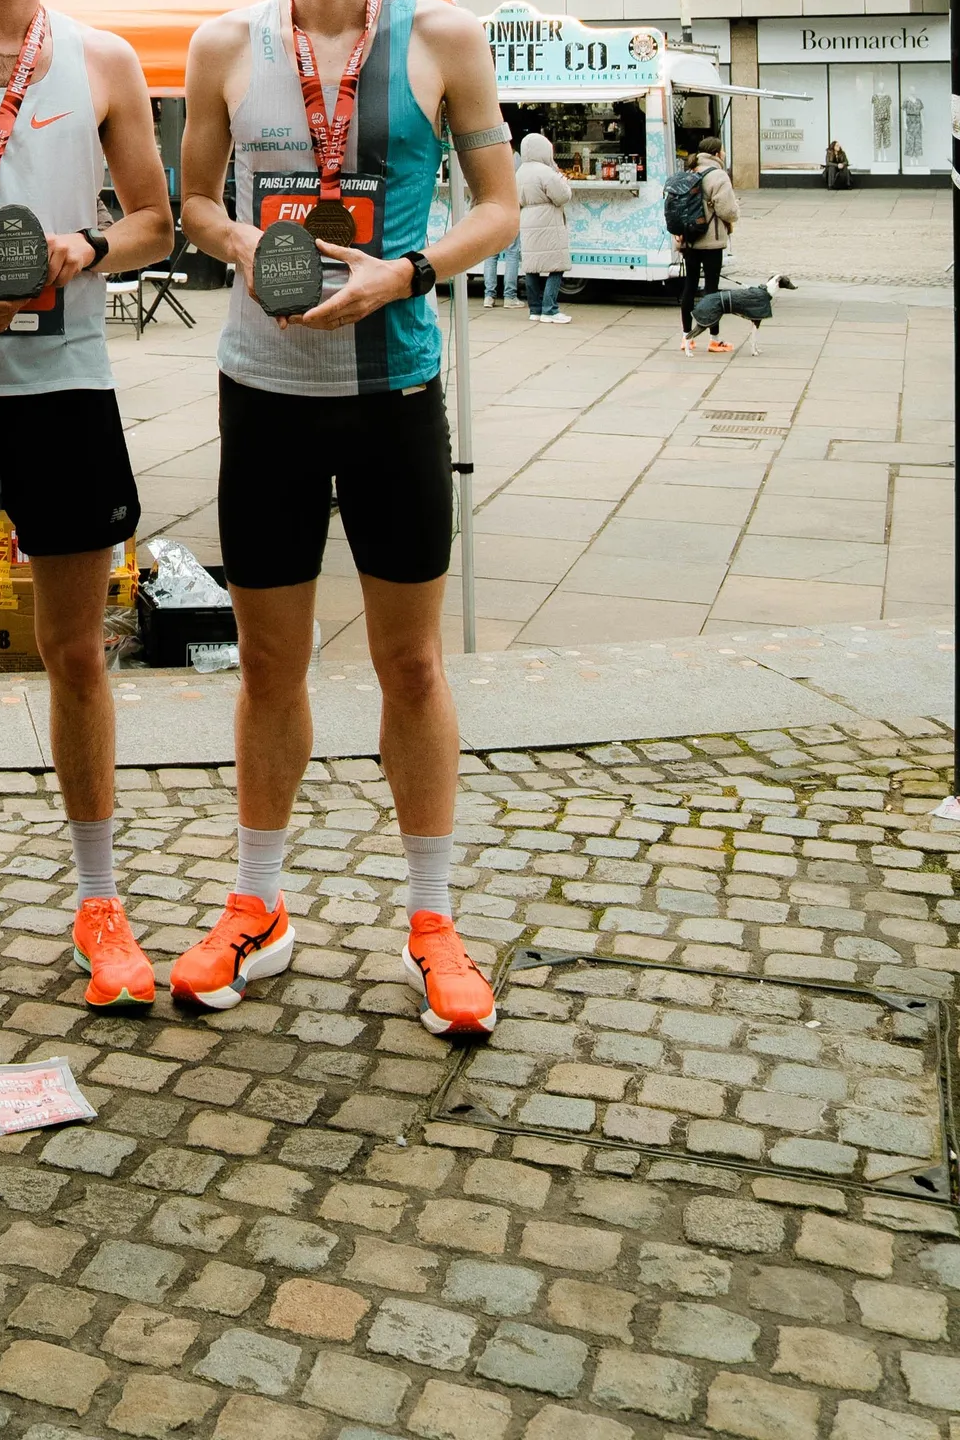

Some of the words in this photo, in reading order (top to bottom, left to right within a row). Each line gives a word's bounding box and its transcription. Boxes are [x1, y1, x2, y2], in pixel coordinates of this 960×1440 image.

[482, 19, 564, 43] OMMER
[261, 26, 276, 63] soar
[799, 27, 929, 51] Bonmarché
[296, 35, 315, 77] MARATHON
[11, 63, 31, 94] PAISLEY
[22, 44, 37, 64] HALF
[261, 127, 291, 138] EAST
[330, 116, 343, 155] FUTURE
[242, 141, 308, 152] SUTHERLAND
[259, 178, 295, 189] PAISLEY
[296, 177, 321, 189] HALF
[340, 179, 379, 191] RATHON
[6, 254, 38, 262] MARATHON
[579, 255, 607, 264] FINEST
[618, 256, 642, 265] TEAS
[261, 260, 311, 274] PAISLEY
[279, 268, 312, 277] MARATHON
